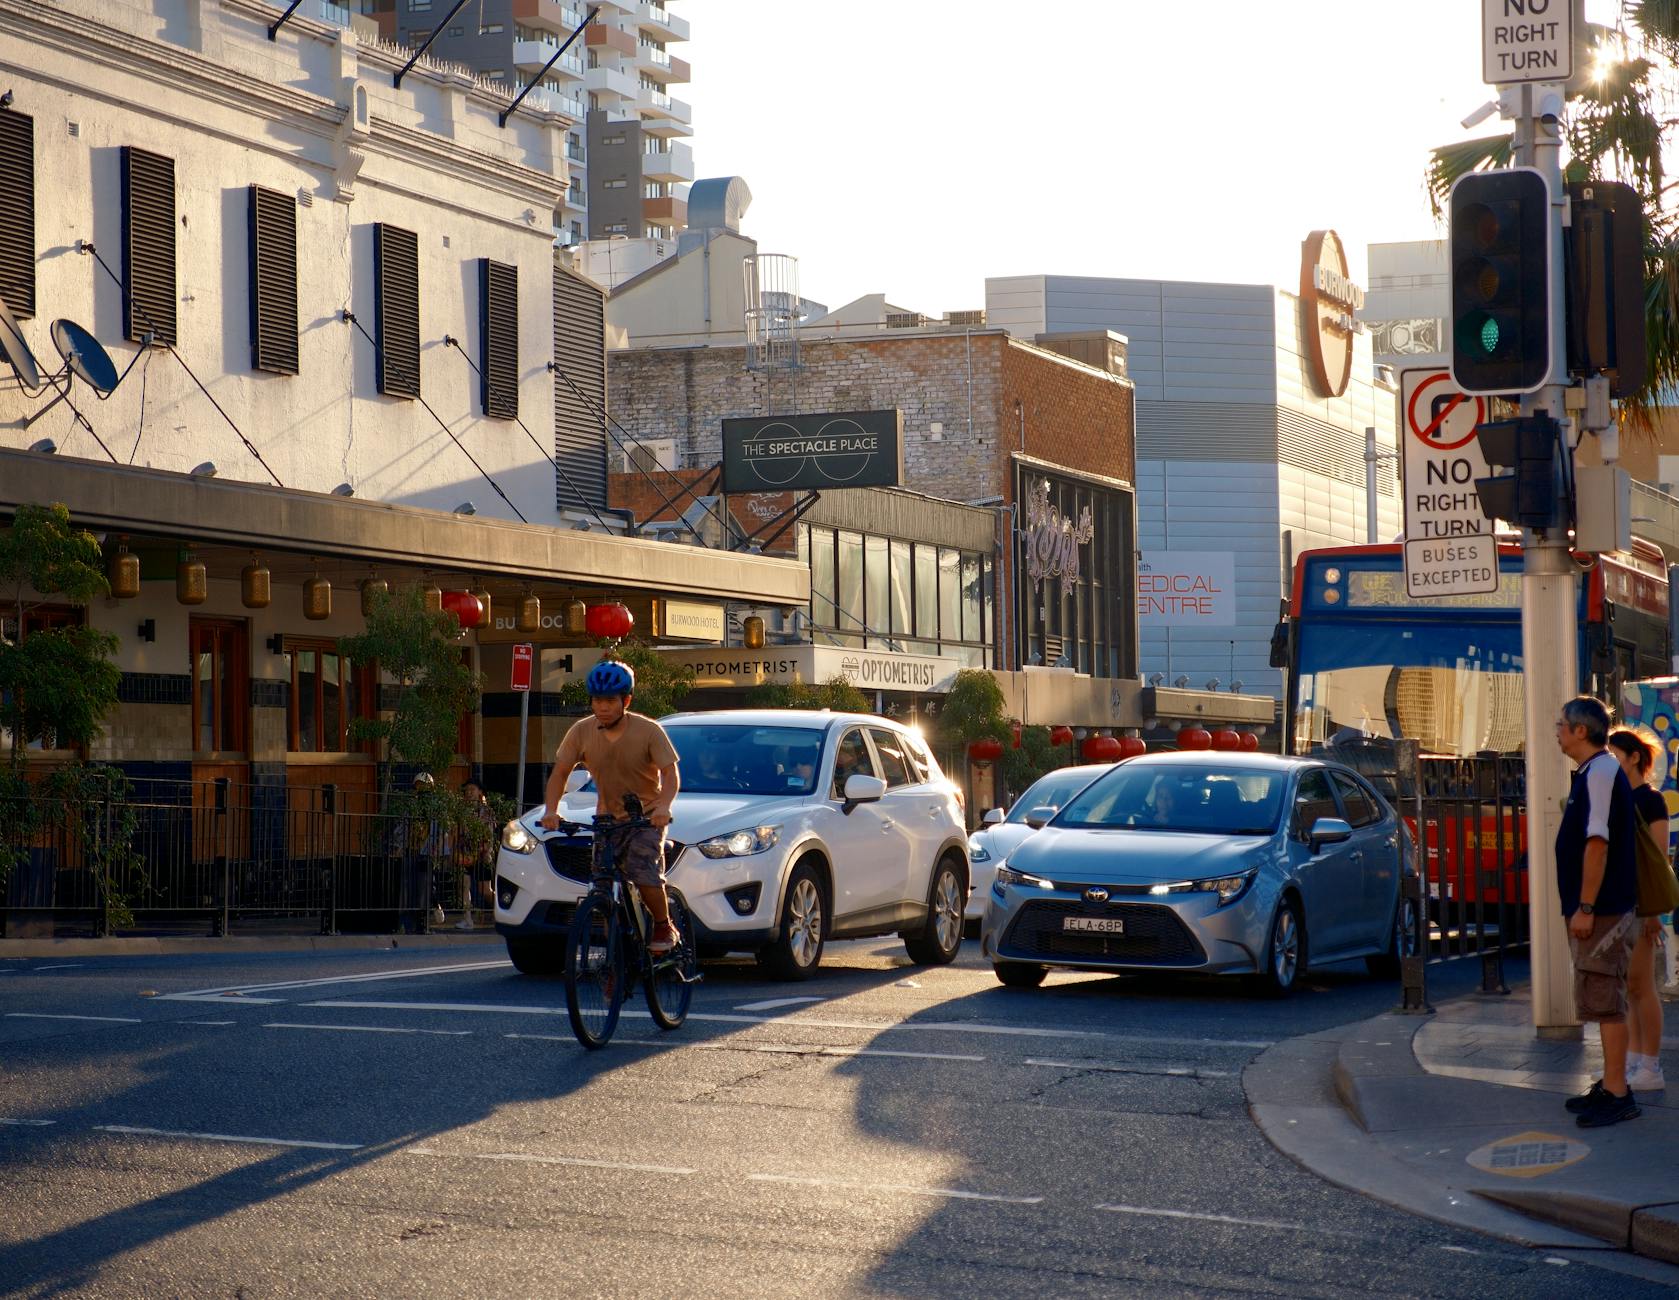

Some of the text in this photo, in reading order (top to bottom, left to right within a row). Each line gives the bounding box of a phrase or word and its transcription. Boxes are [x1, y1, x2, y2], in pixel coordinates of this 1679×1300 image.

[1503, 0, 1549, 17] NO
[1494, 22, 1559, 44] RIGHT
[1497, 49, 1557, 71] TURN
[743, 437, 878, 456] THE SPECTACLE PLACE
[1427, 458, 1472, 485] NO
[1417, 493, 1480, 512] RIGHT
[1420, 519, 1480, 537] TURN
[1422, 546, 1478, 563] BUSES
[1137, 575, 1222, 593] EDICAL
[1412, 567, 1491, 586] EXCEPTED
[1137, 597, 1216, 614] ENTRE
[671, 614, 720, 629] BURWOOD HOTEL
[862, 659, 935, 686] OPTOMETRIST
